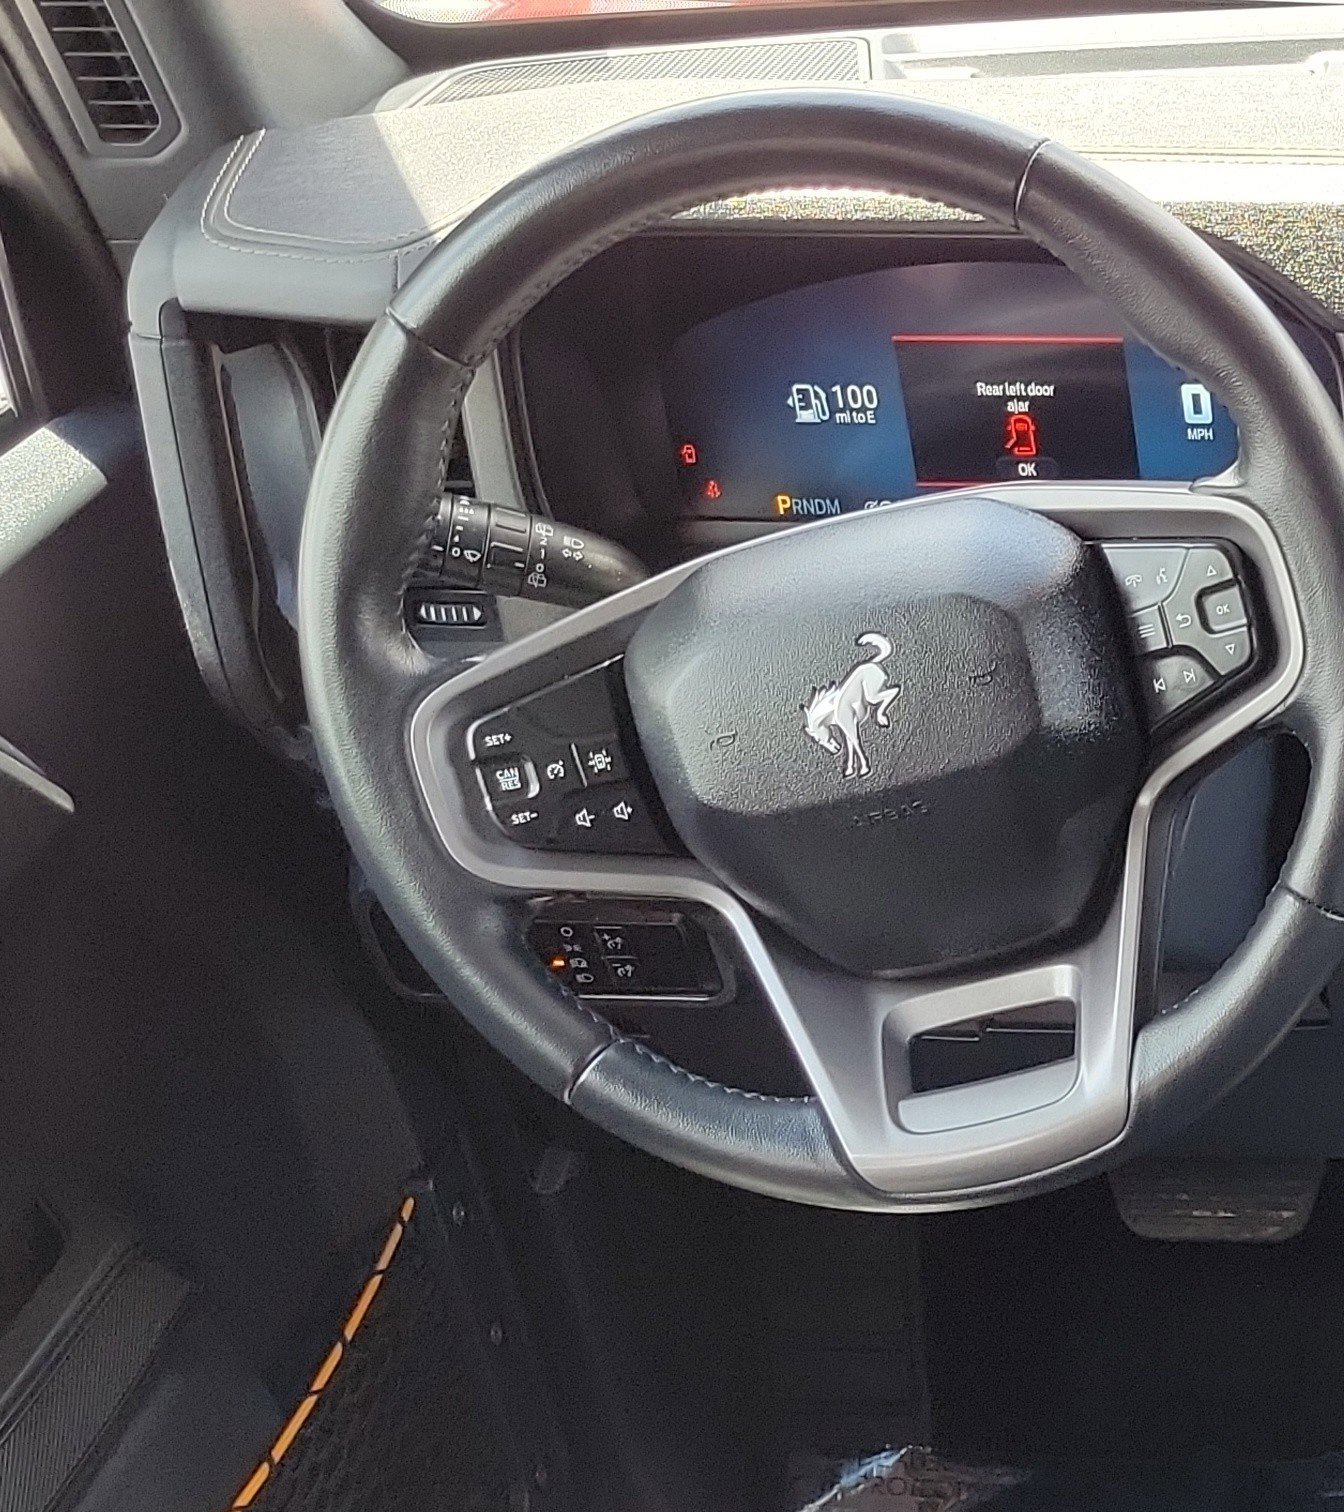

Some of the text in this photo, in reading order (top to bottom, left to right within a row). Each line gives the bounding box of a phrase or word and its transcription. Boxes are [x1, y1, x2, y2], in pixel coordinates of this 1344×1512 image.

[976, 381, 1055, 396] Rear left door
[831, 384, 879, 409] 100
[1181, 383, 1213, 424] 0
[1006, 398, 1030, 414] ajar
[852, 411, 865, 424] to
[866, 410, 877, 424] E
[1187, 427, 1214, 440] MPH
[1017, 462, 1038, 477] OK
[1215, 603, 1231, 615] OK
[495, 767, 519, 780] CAN
[501, 780, 522, 791] RES
